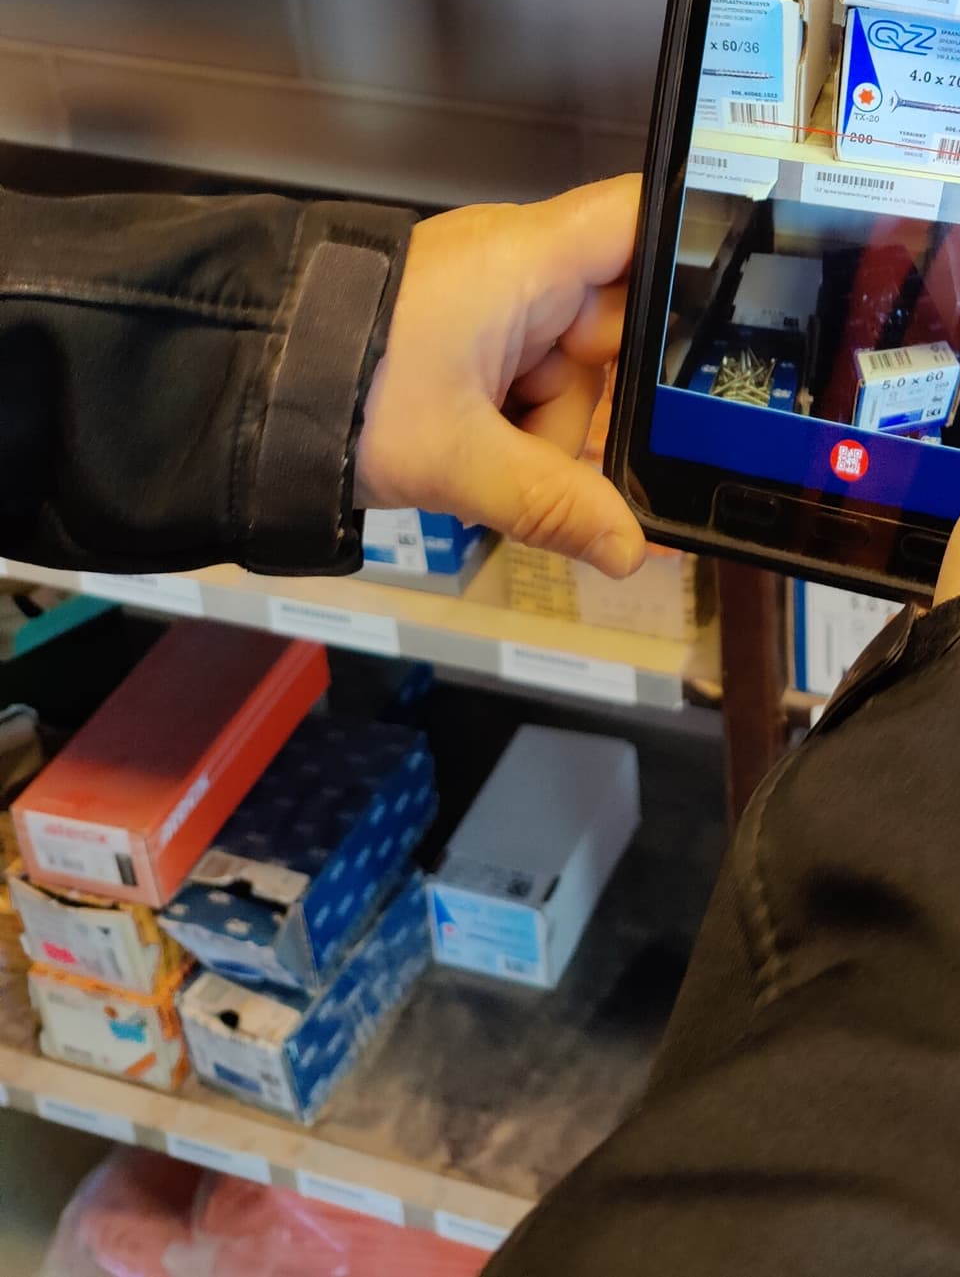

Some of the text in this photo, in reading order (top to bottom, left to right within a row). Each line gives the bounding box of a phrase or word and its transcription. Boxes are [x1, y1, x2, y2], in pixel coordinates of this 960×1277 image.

[868, 20, 937, 56] QZ
[709, 40, 761, 54] x 60/36
[909, 69, 932, 84] 4.0
[935, 76, 944, 85] x
[853, 113, 880, 123] TX-20
[849, 132, 873, 145] 200
[881, 370, 945, 391] 5.0 x 60
